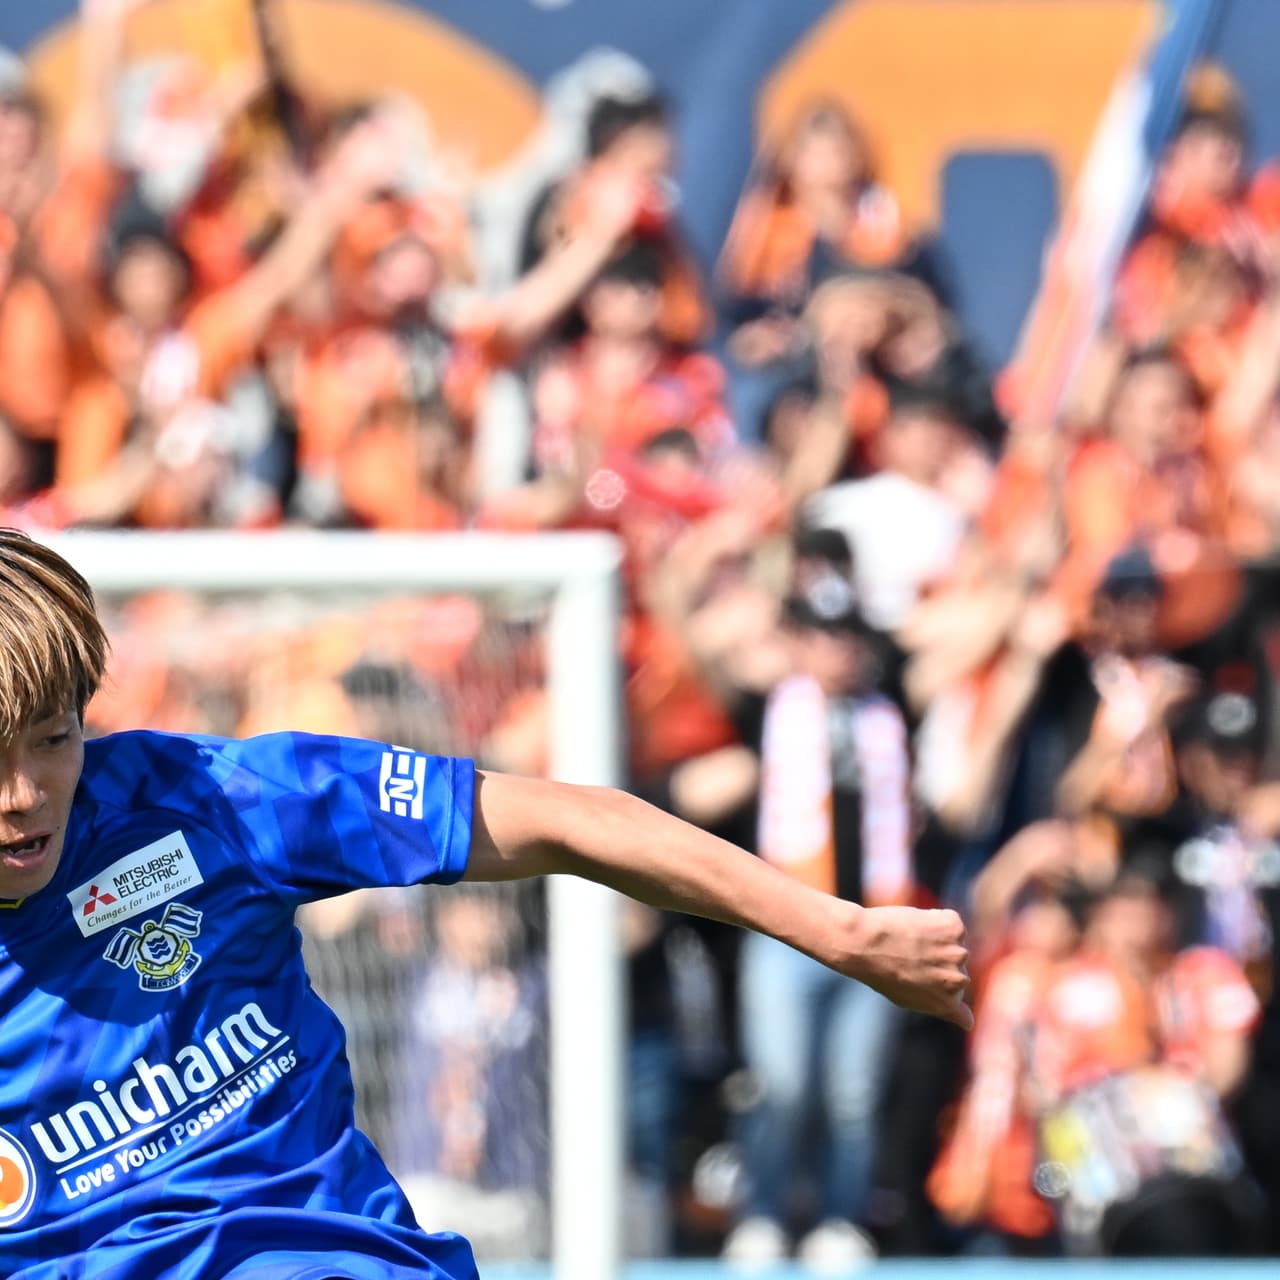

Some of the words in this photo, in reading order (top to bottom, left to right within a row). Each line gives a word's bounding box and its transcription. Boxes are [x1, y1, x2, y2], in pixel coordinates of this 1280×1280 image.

[112, 848, 184, 888] MITSUBISHI
[117, 864, 180, 899] ELECTRIC
[87, 905, 127, 928] Changes
[129, 896, 143, 911] for
[146, 889, 161, 901] the
[163, 875, 193, 894] Better
[30, 1002, 283, 1164] unicharm
[59, 1162, 115, 1200] Love
[115, 1136, 167, 1174] Your
[169, 1049, 297, 1147] Possibilities
